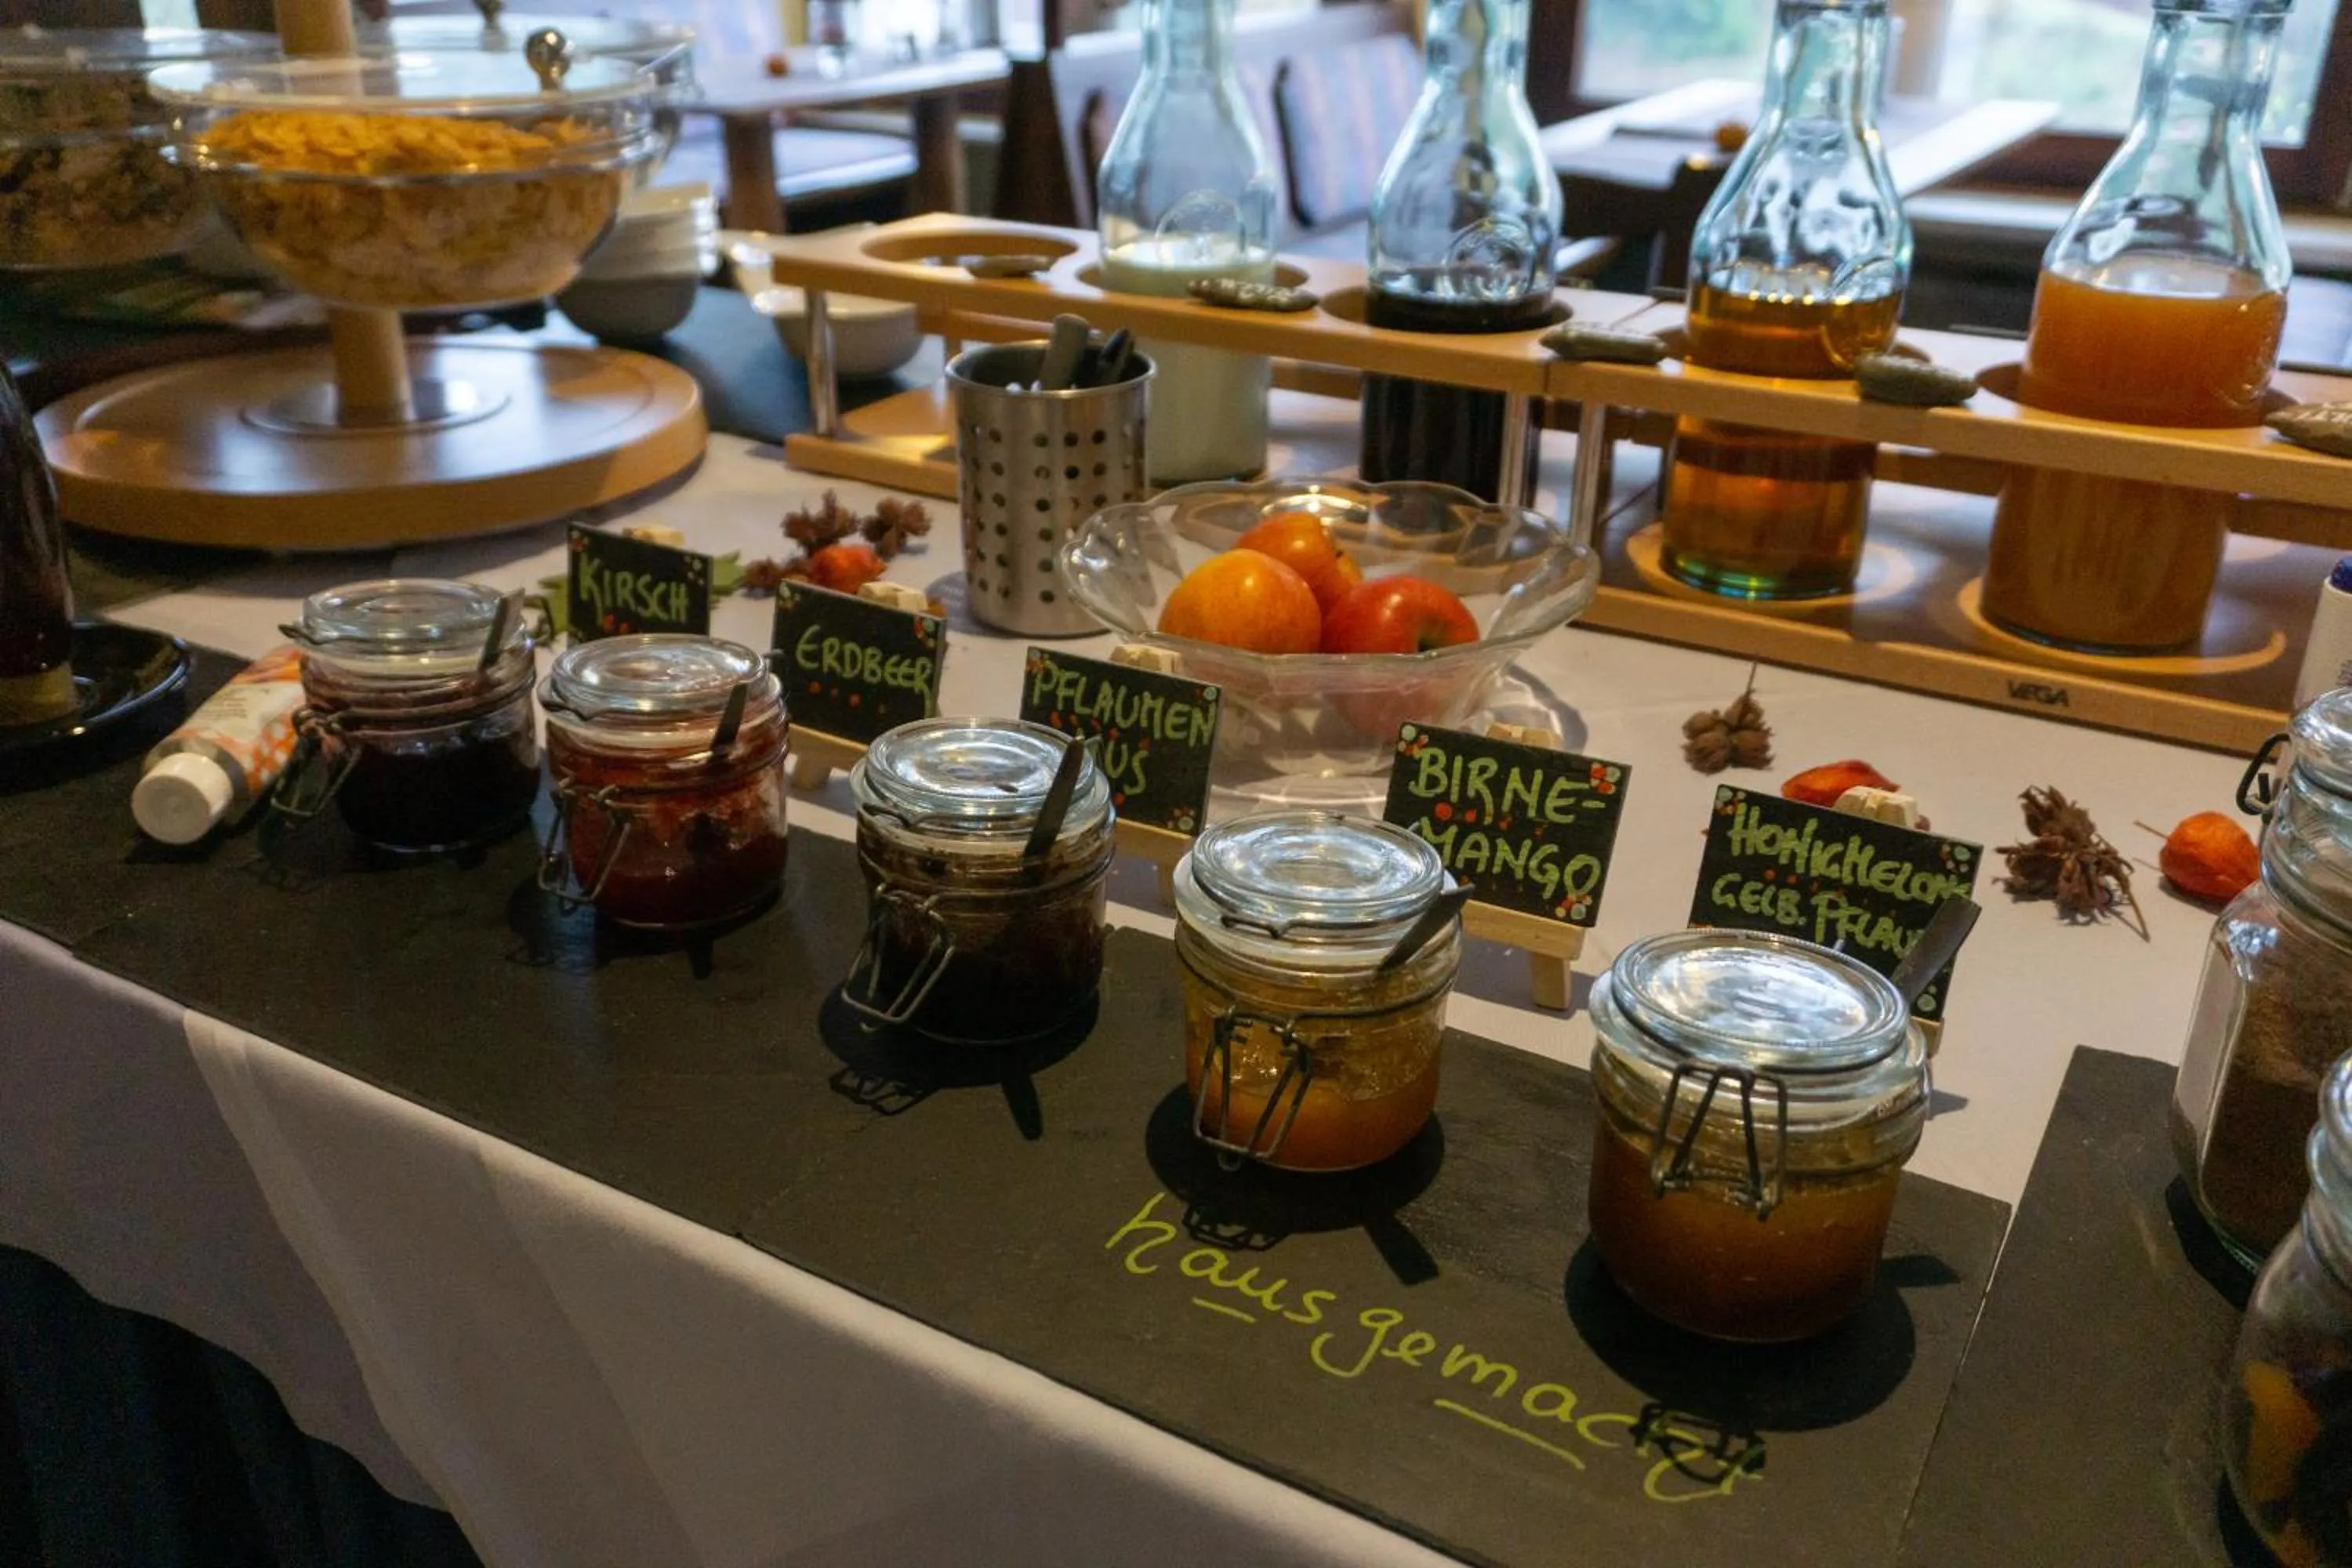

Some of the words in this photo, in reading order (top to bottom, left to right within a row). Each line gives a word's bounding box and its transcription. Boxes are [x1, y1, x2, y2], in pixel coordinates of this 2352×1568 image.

[579, 552, 689, 623] KIRSCH
[795, 625, 933, 712] ERDBEER
[1032, 660, 1215, 747] PFLAUMEN
[2007, 679, 2069, 706] VEGA
[1091, 731, 1150, 796] US
[1811, 891, 1925, 960] PFLAU
